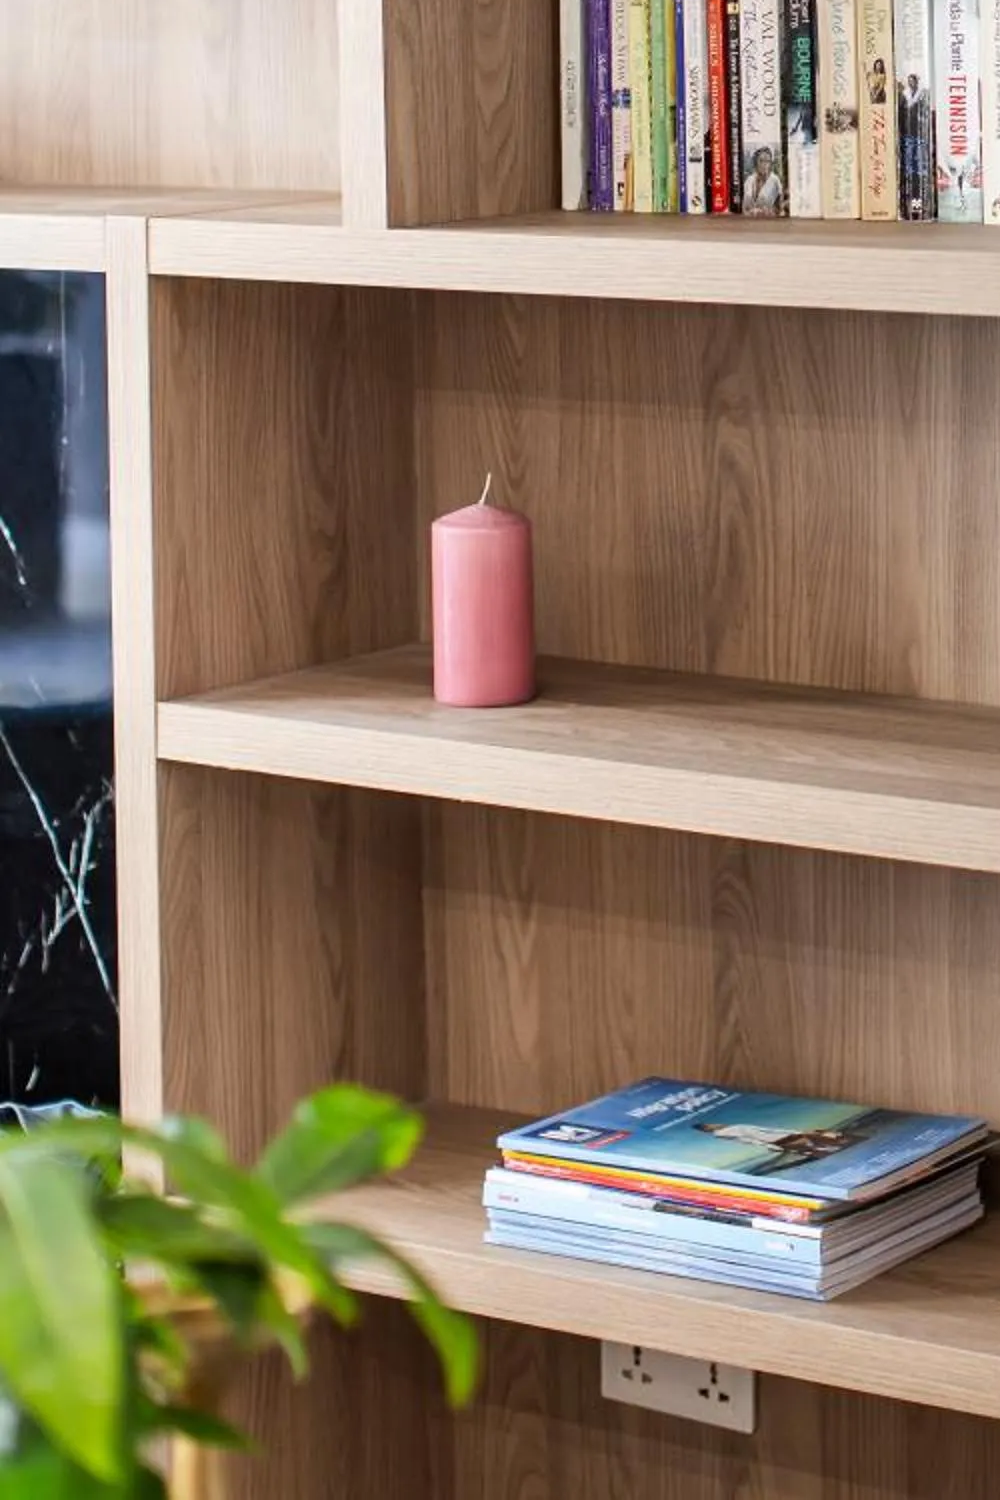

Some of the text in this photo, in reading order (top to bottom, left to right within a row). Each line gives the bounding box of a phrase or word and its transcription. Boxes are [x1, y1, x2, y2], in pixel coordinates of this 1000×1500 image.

[762, 11, 776, 117] VAL WOOD
[950, 33, 965, 71] Plante
[948, 76, 968, 156] TENNISON
